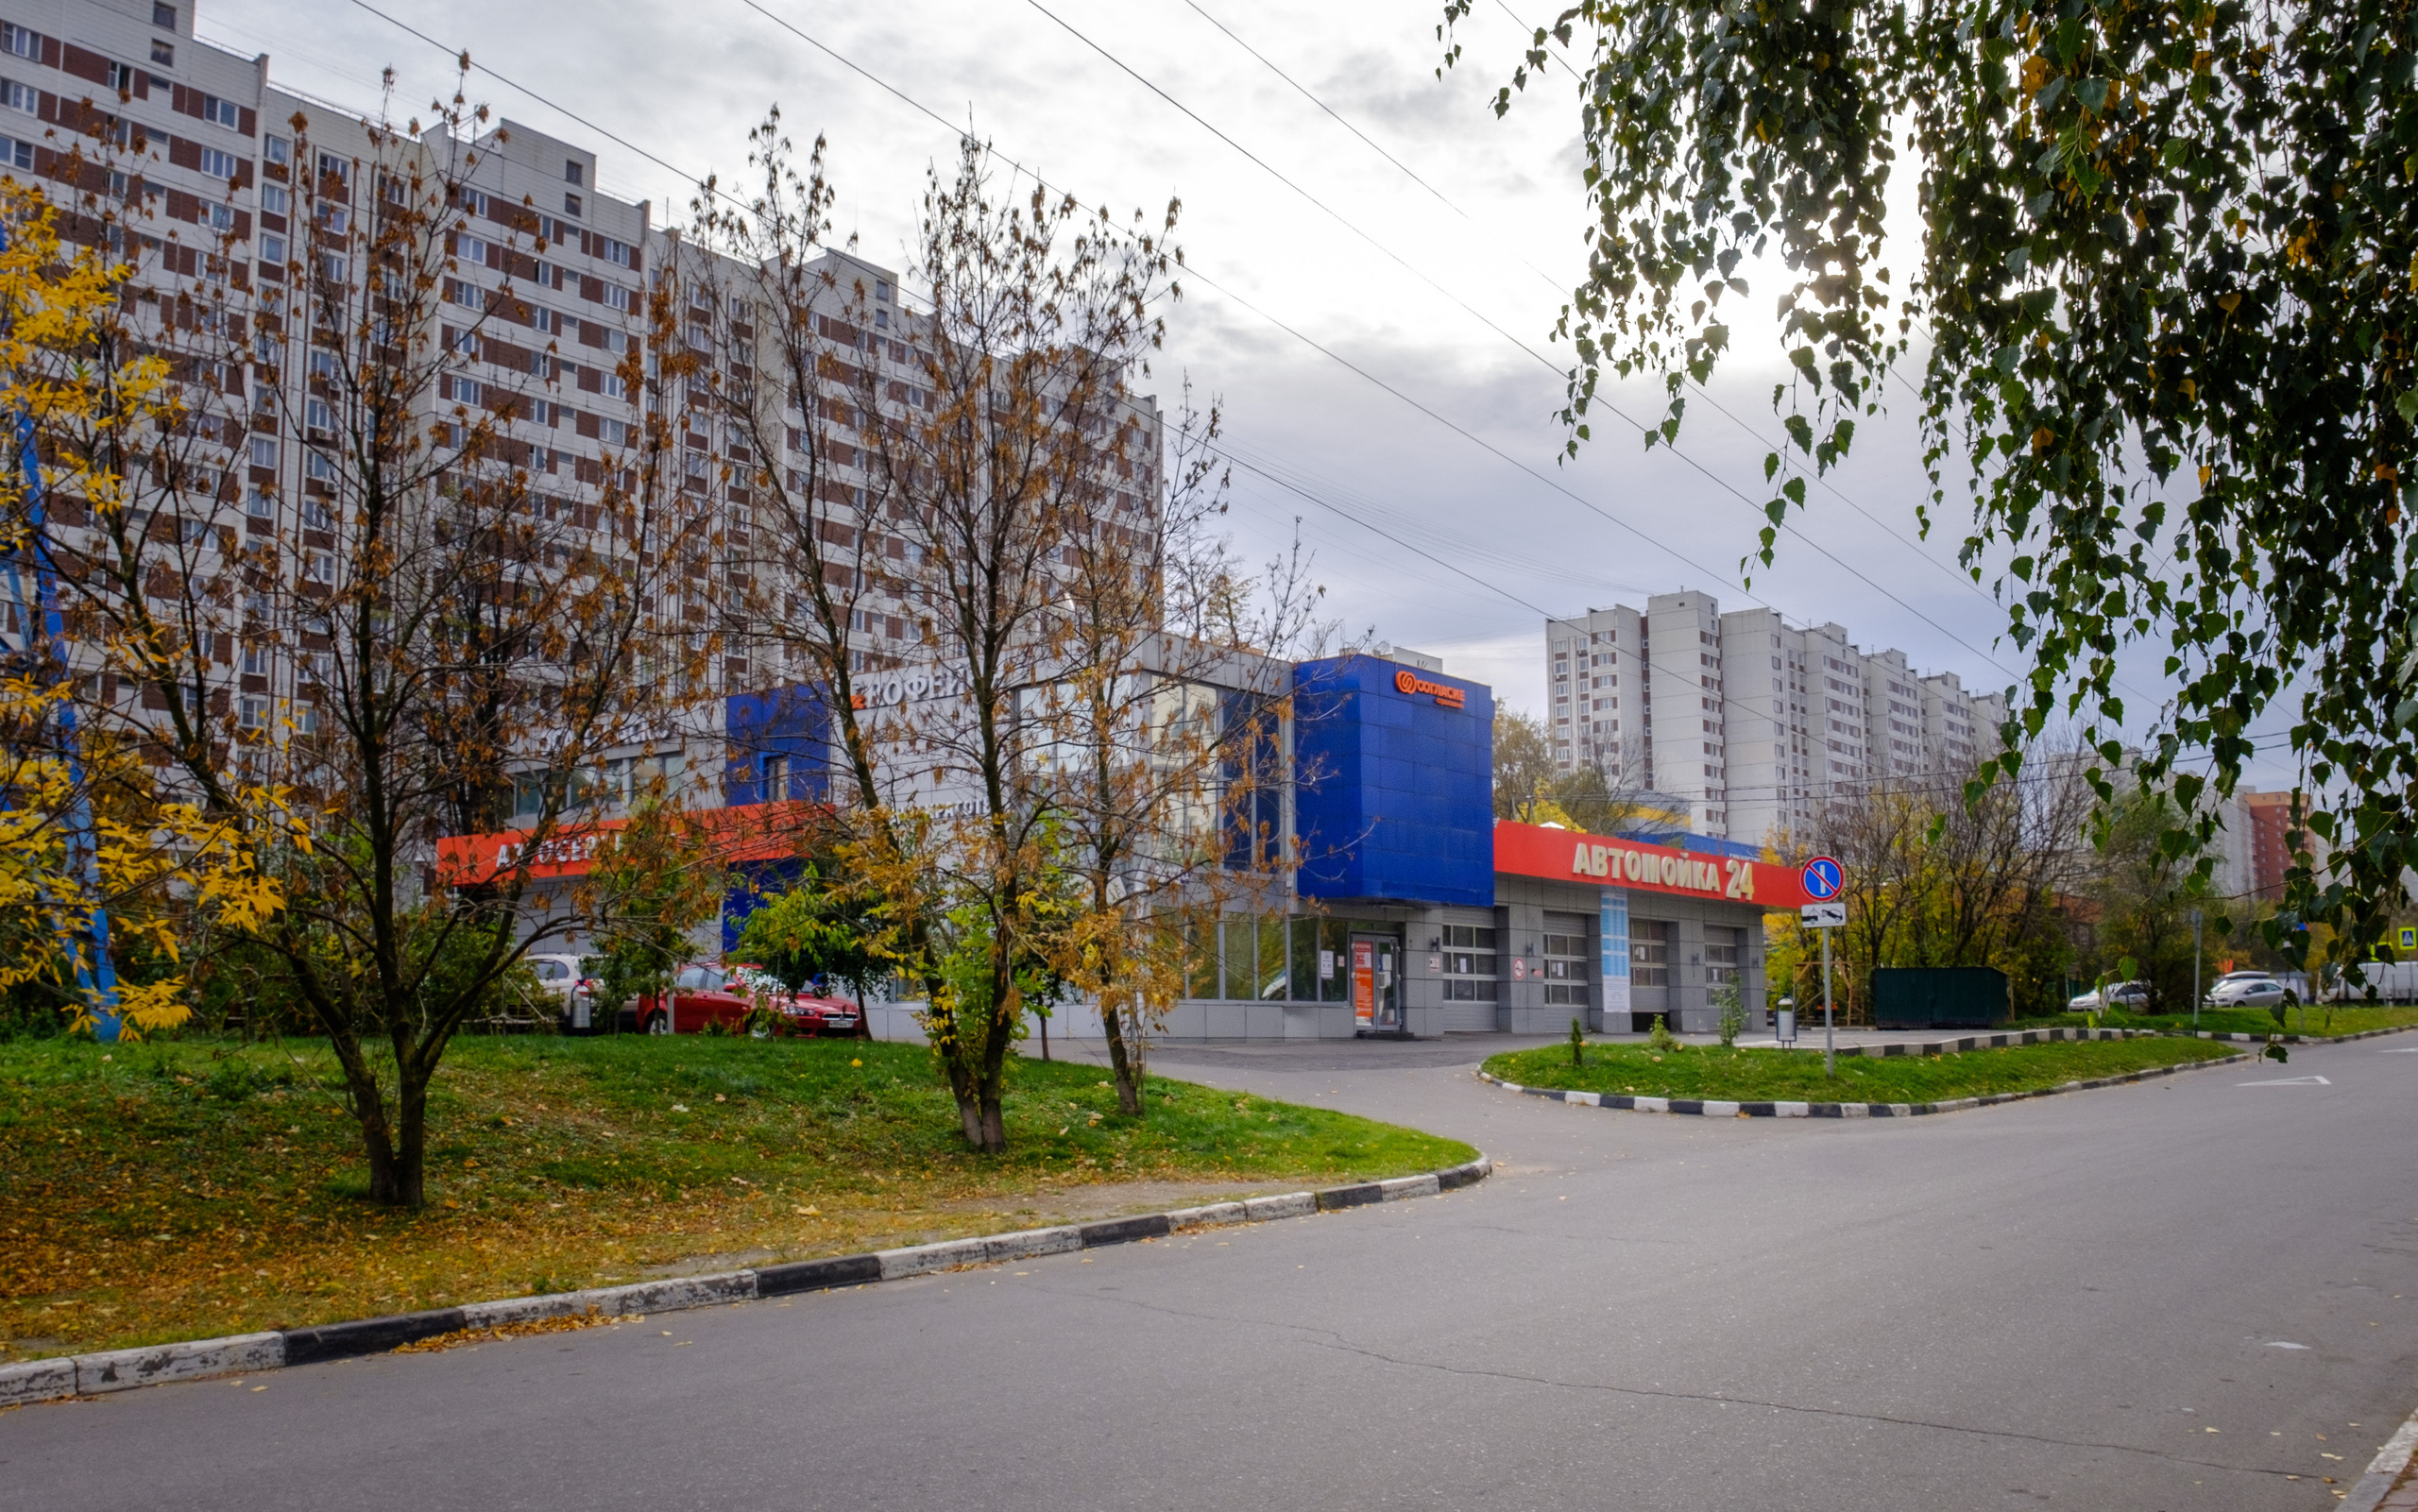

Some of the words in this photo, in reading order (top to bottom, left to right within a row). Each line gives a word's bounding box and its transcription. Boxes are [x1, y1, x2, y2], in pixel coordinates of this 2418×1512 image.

[1417, 679, 1465, 702] СОГЛАСИЕ
[1573, 842, 1721, 892] АВТОМОЙКА
[1726, 859, 1755, 901] 24
